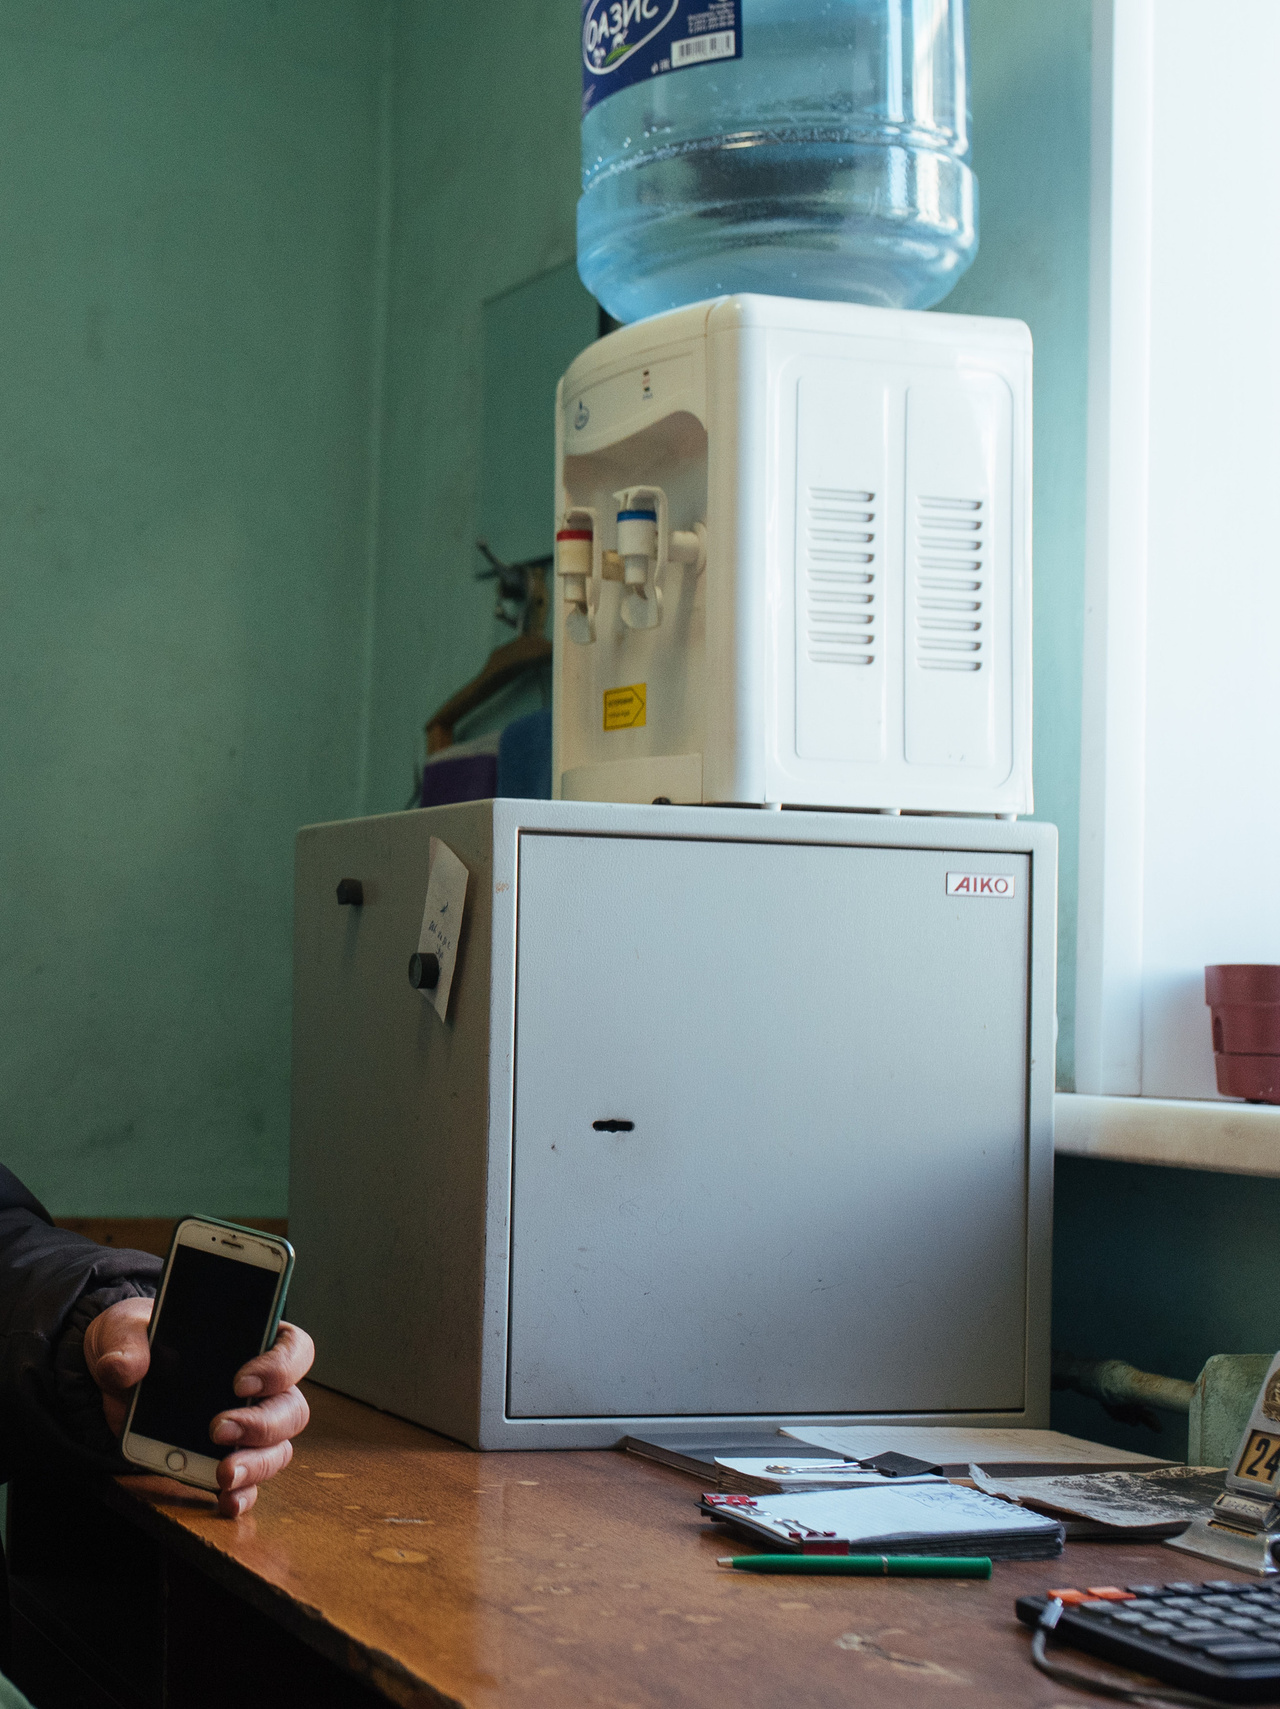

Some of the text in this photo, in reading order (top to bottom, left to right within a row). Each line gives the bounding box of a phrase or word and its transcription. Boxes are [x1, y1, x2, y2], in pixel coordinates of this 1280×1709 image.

[587, 0, 659, 52] ОАЗИС
[954, 877, 1008, 893] AIKO
[1246, 1438, 1280, 1481] 24
